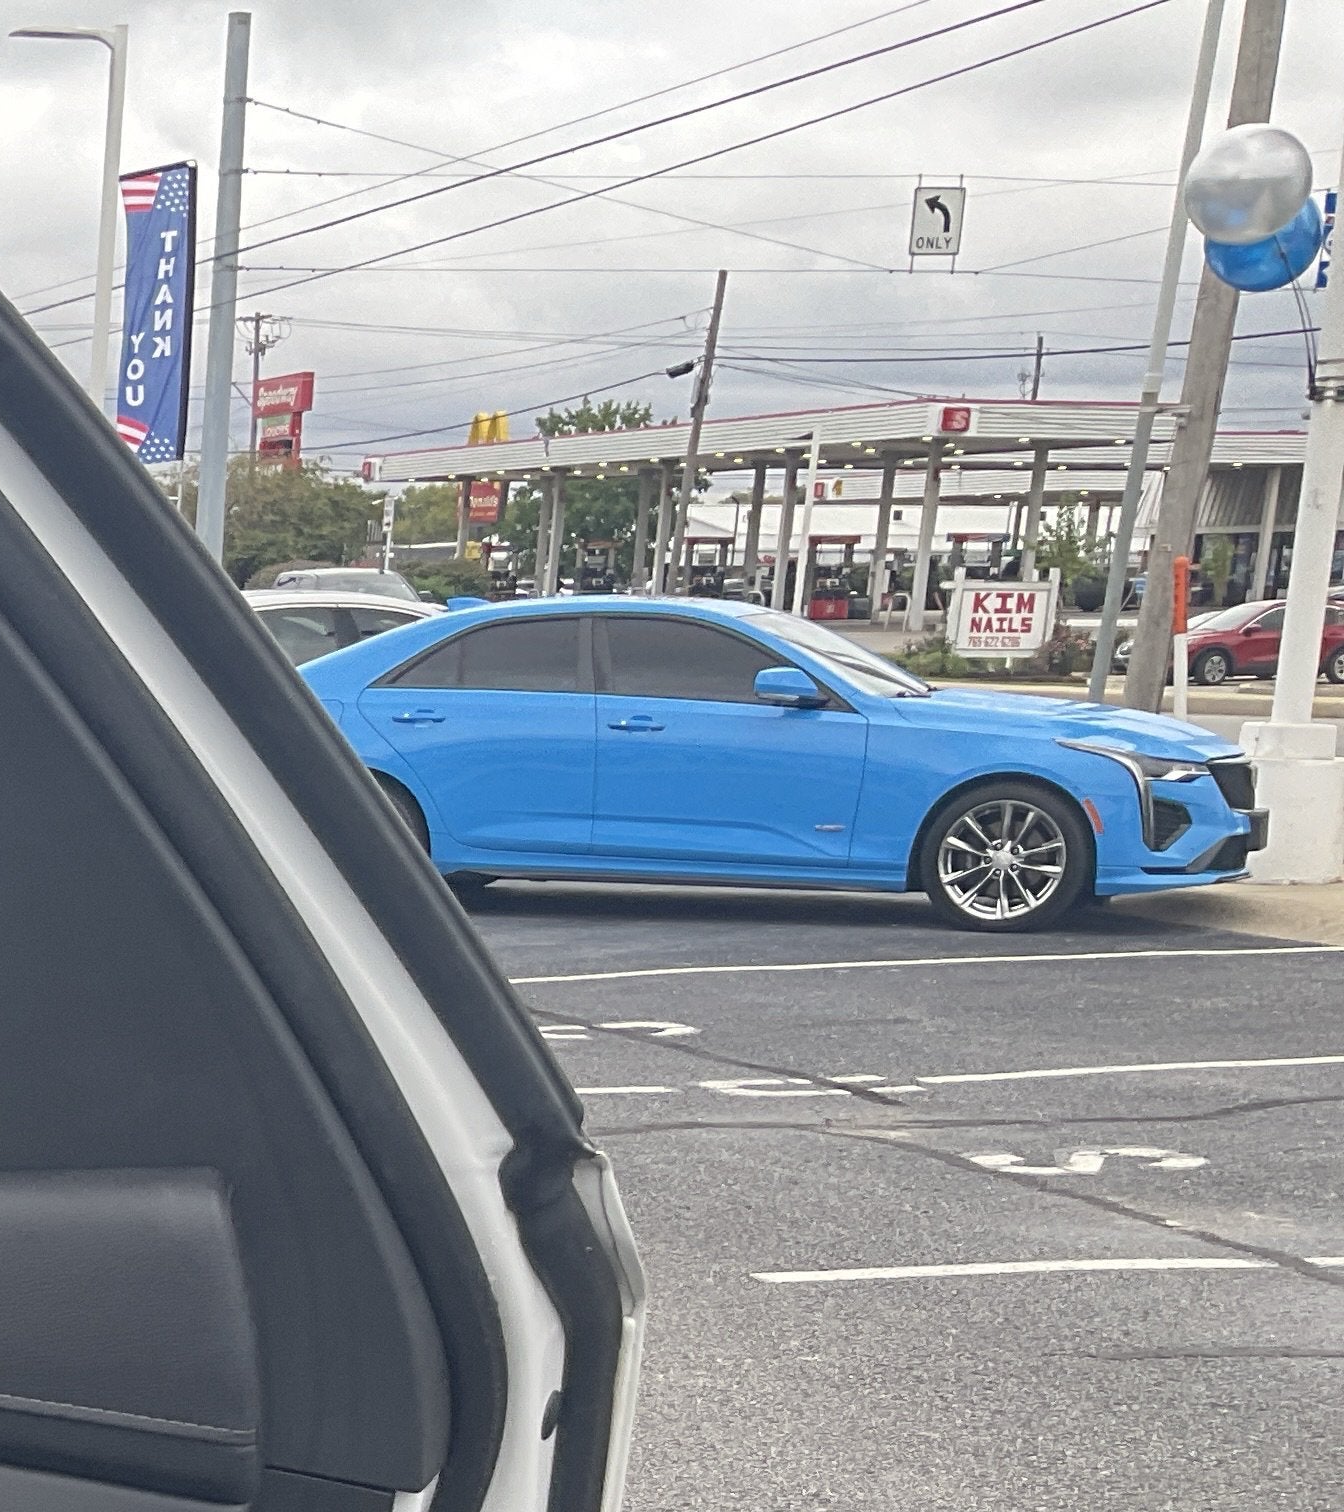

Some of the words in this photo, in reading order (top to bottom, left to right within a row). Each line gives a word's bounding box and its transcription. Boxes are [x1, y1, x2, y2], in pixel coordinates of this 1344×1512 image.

[915, 236, 953, 250] ONLY
[972, 592, 1037, 614] KIM
[970, 617, 1033, 633] NAILS
